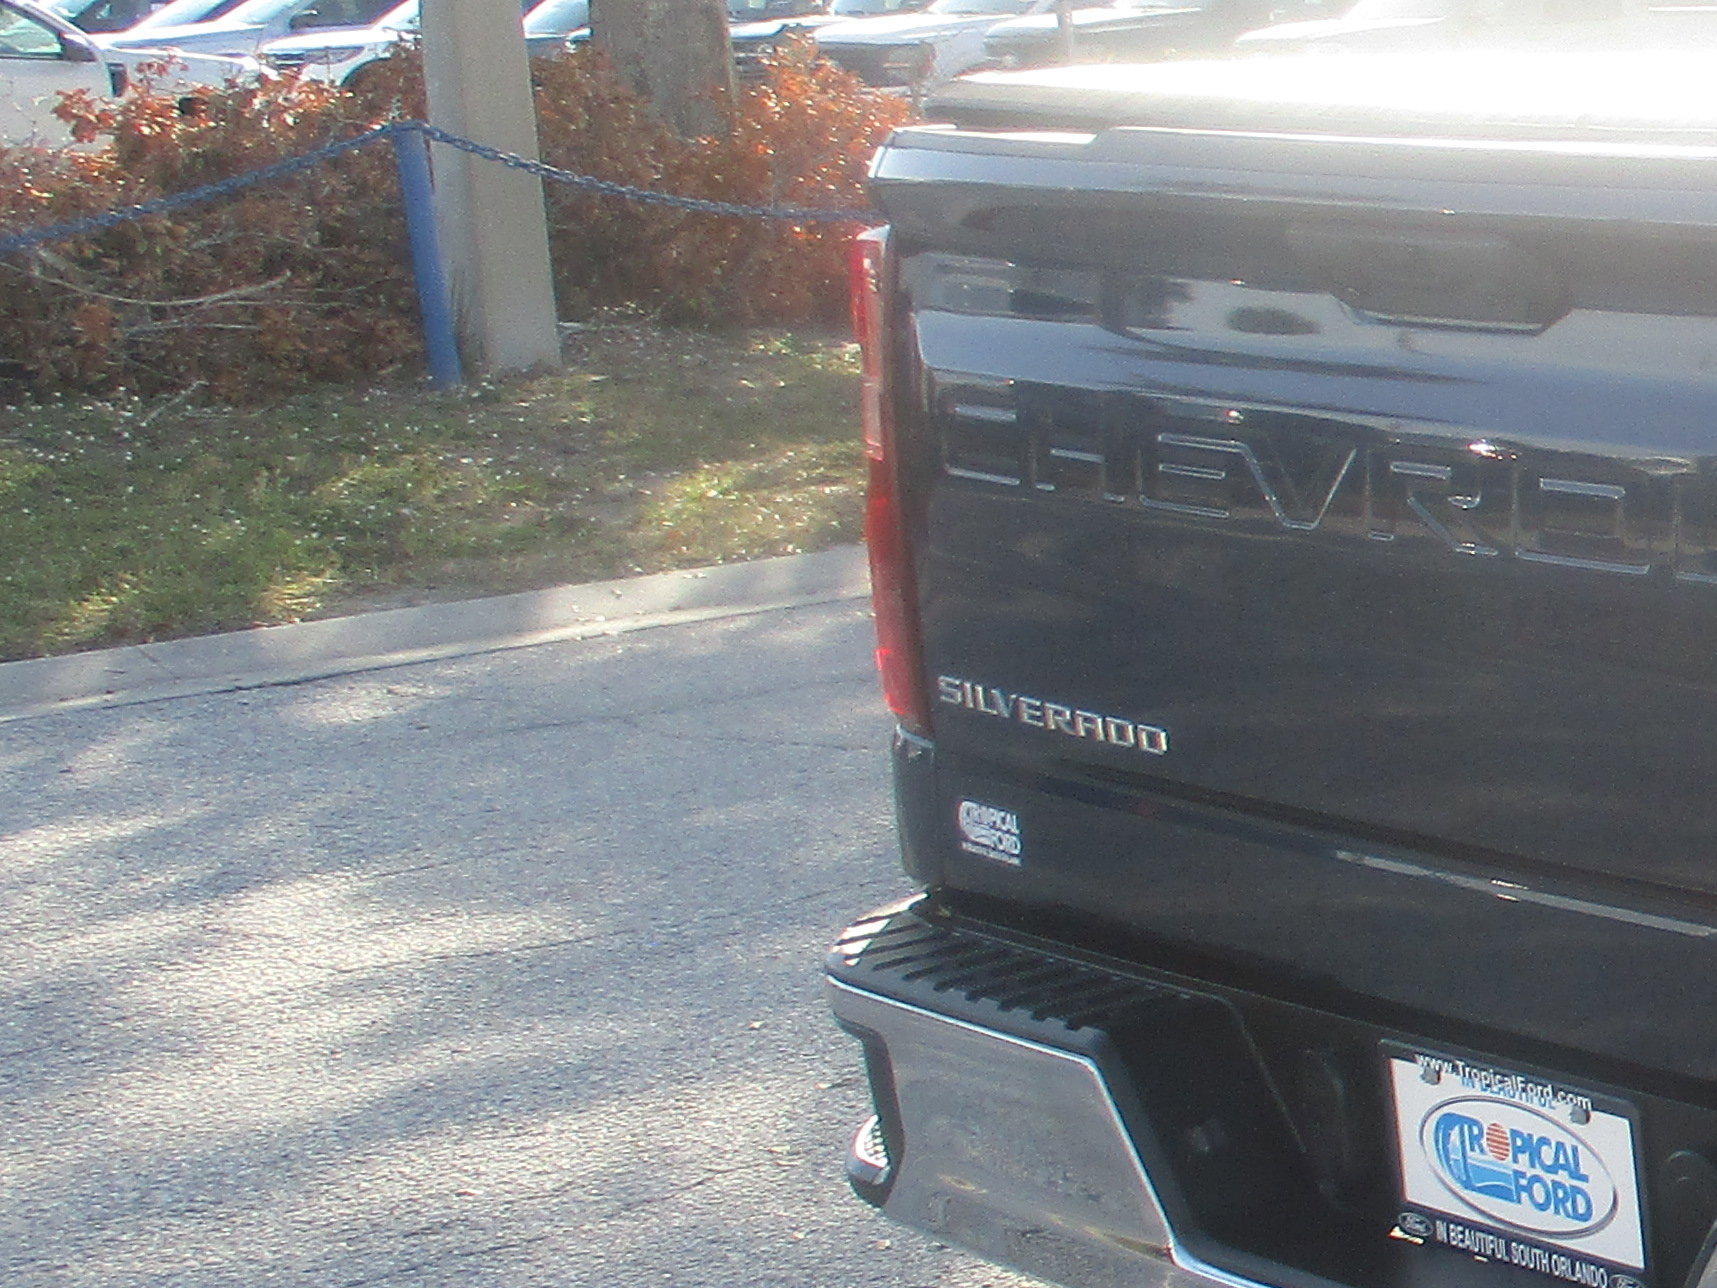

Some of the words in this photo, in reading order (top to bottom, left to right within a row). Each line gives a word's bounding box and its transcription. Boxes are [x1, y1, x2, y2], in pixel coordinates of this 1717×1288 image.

[937, 674, 1169, 756] SILVERADO
[1415, 1054, 1593, 1111] www.TropicalFord.com
[1511, 1169, 1593, 1223] FORD
[1436, 1220, 1448, 1244] IN
[1449, 1223, 1510, 1262] BEAUTIFUL
[1511, 1242, 1550, 1273] SOUTH
